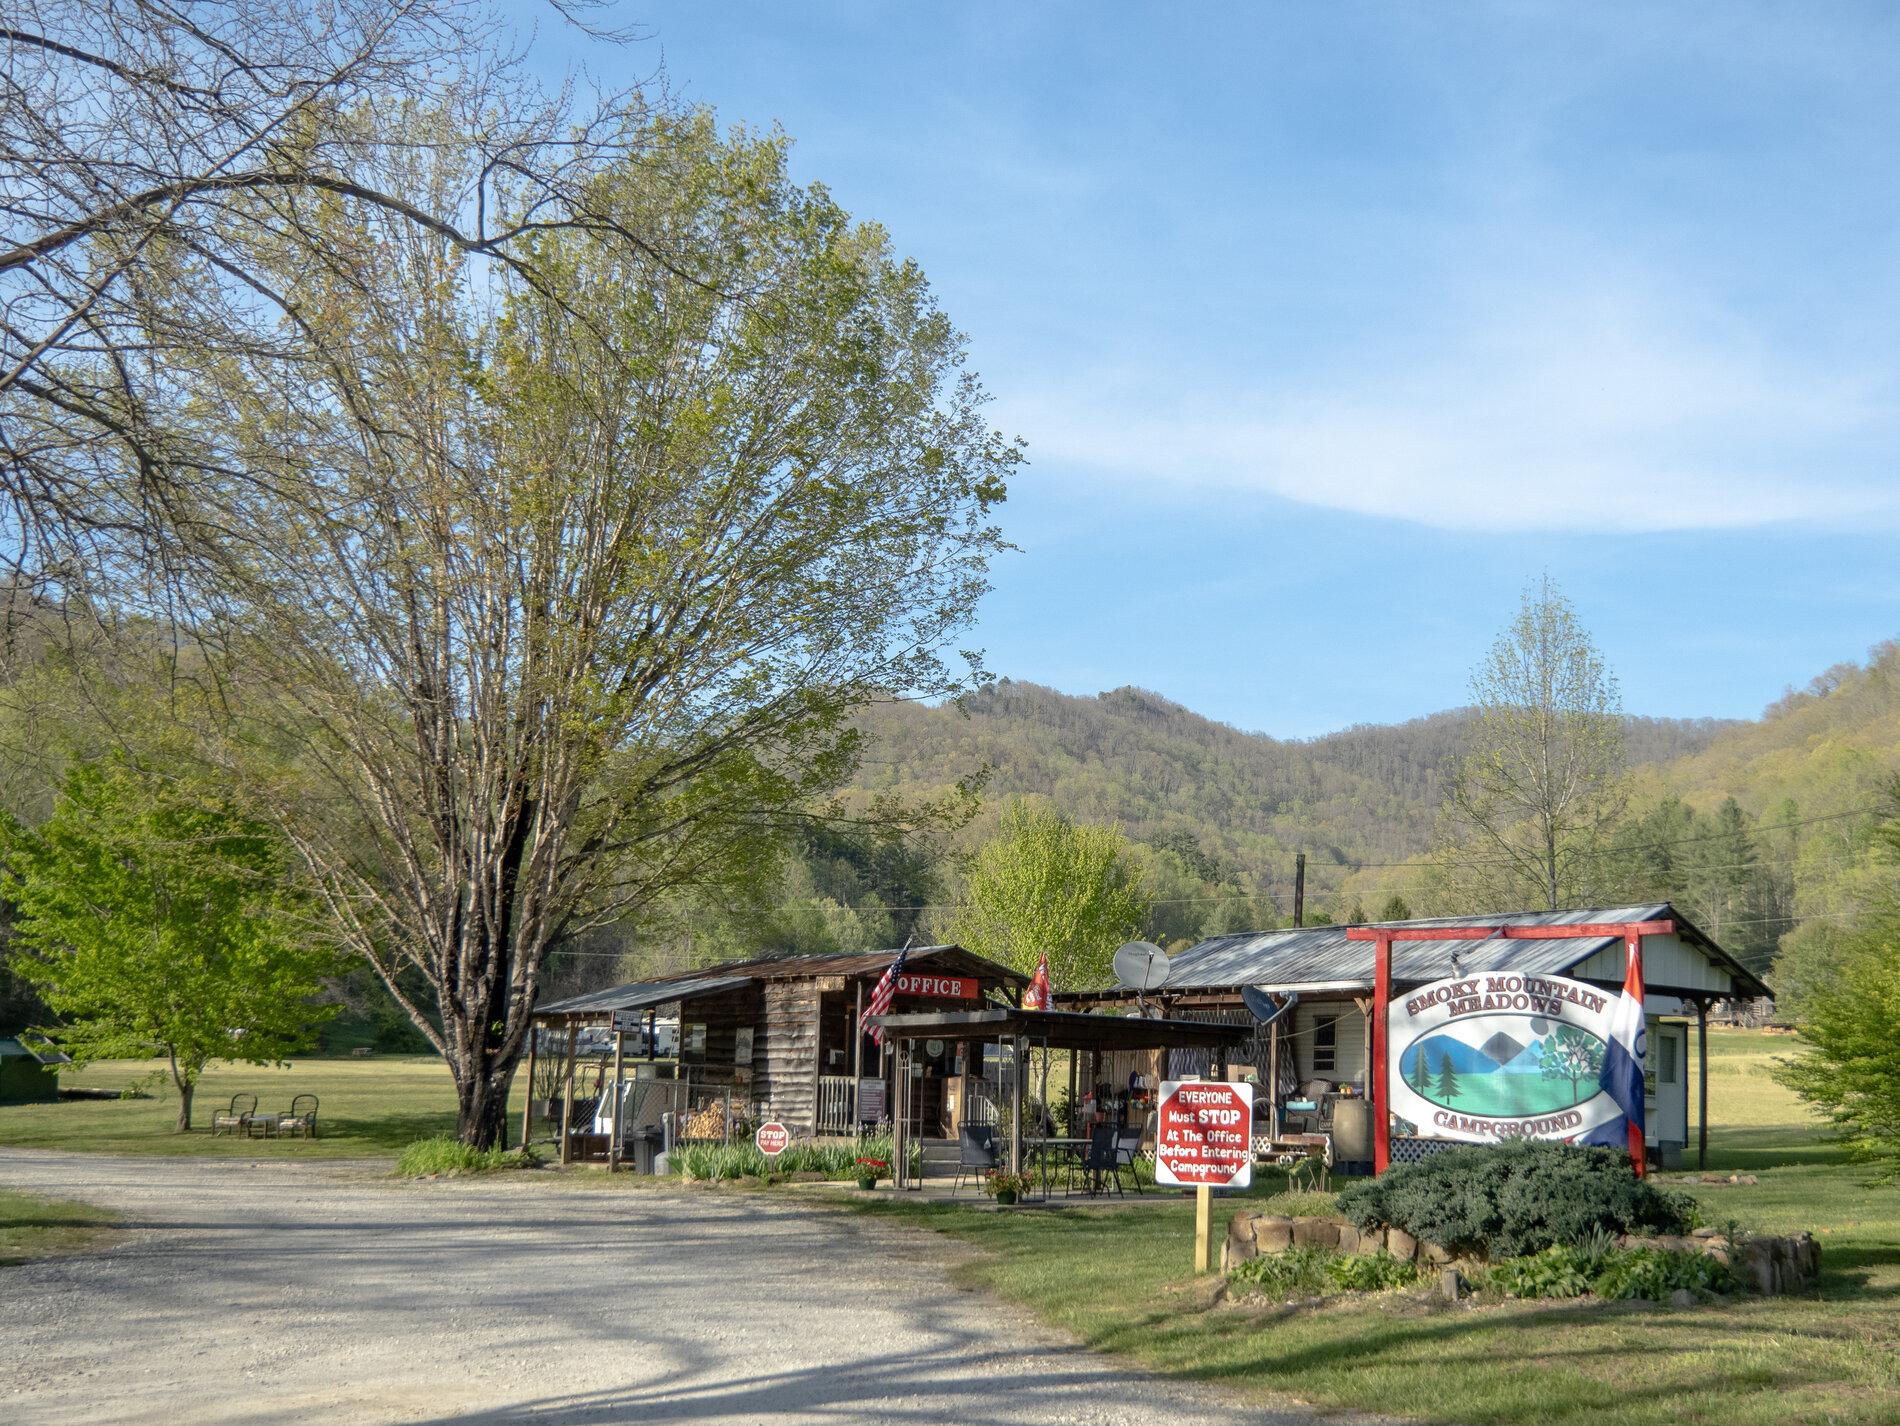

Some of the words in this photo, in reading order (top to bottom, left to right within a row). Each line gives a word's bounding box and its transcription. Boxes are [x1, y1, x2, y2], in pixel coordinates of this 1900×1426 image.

[897, 977, 961, 996] OFFICE
[1406, 979, 1480, 1016] SMOKY
[1486, 976, 1607, 1015] MOUNTAIN
[1446, 994, 1563, 1018] MEADOWS
[1178, 1091, 1232, 1104] EVERYONE
[1169, 1110, 1195, 1122] Must
[1199, 1109, 1241, 1125] STOP
[1433, 1110, 1583, 1136] CAMPGROUND
[760, 1130, 785, 1139] STOP
[1166, 1129, 1179, 1141] At
[1182, 1130, 1203, 1142] The
[1207, 1130, 1242, 1143] Office
[1159, 1144, 1198, 1157] Before
[1201, 1146, 1248, 1163] Entering
[1170, 1160, 1237, 1179] Campground
